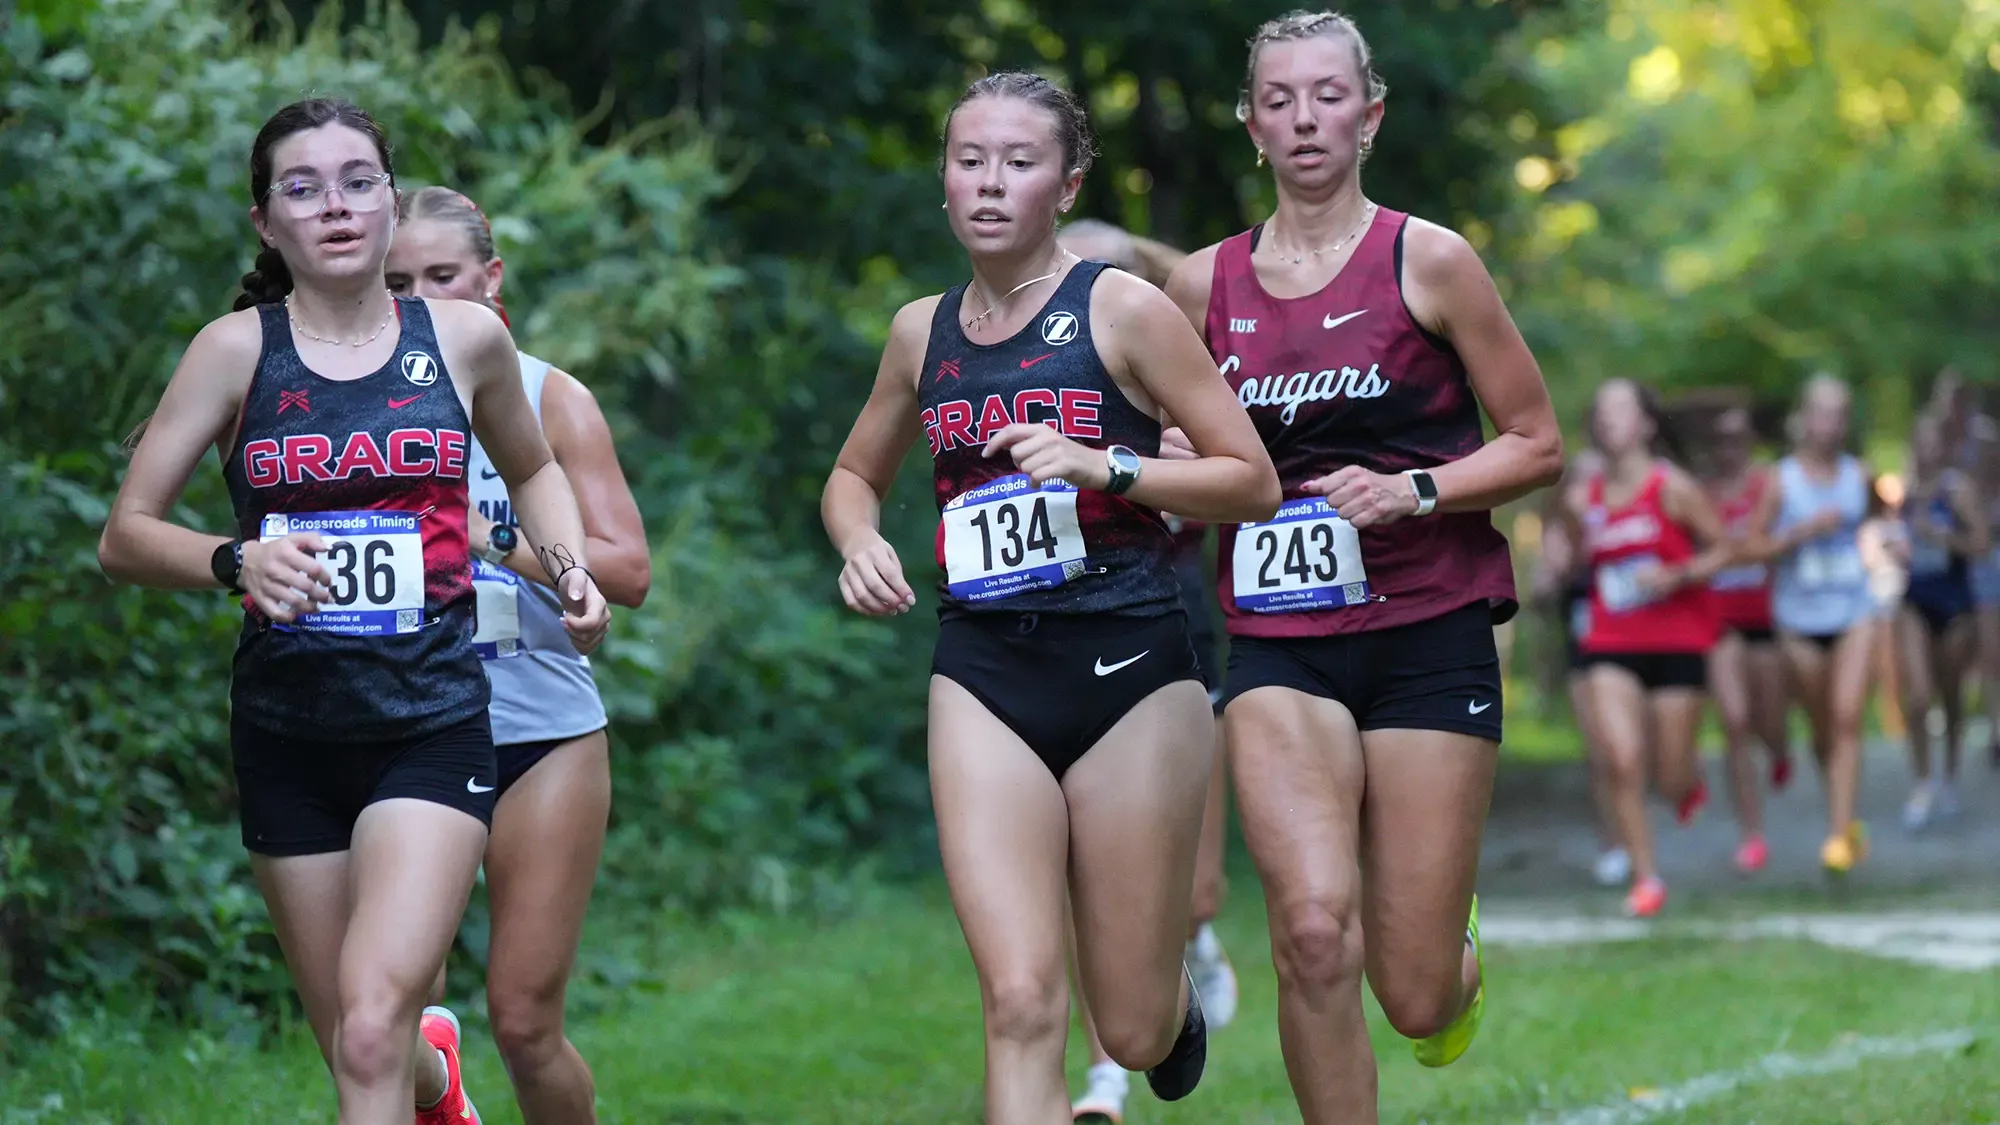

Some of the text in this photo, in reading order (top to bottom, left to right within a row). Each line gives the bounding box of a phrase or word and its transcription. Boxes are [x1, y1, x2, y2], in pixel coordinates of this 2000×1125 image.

[1229, 317, 1258, 333] IUK
[920, 388, 1102, 459] GRACE
[243, 428, 466, 489] GRACE
[966, 479, 1027, 500] Crossroads
[290, 515, 415, 530] Crossroads Timing
[970, 497, 1058, 571] 134
[1256, 523, 1338, 588] 243
[306, 540, 396, 606] 36
[998, 576, 1023, 585] Results
[1269, 595, 1282, 603] Live
[1282, 592, 1305, 601] Results
[322, 614, 351, 622] Results
[352, 614, 360, 622] at
